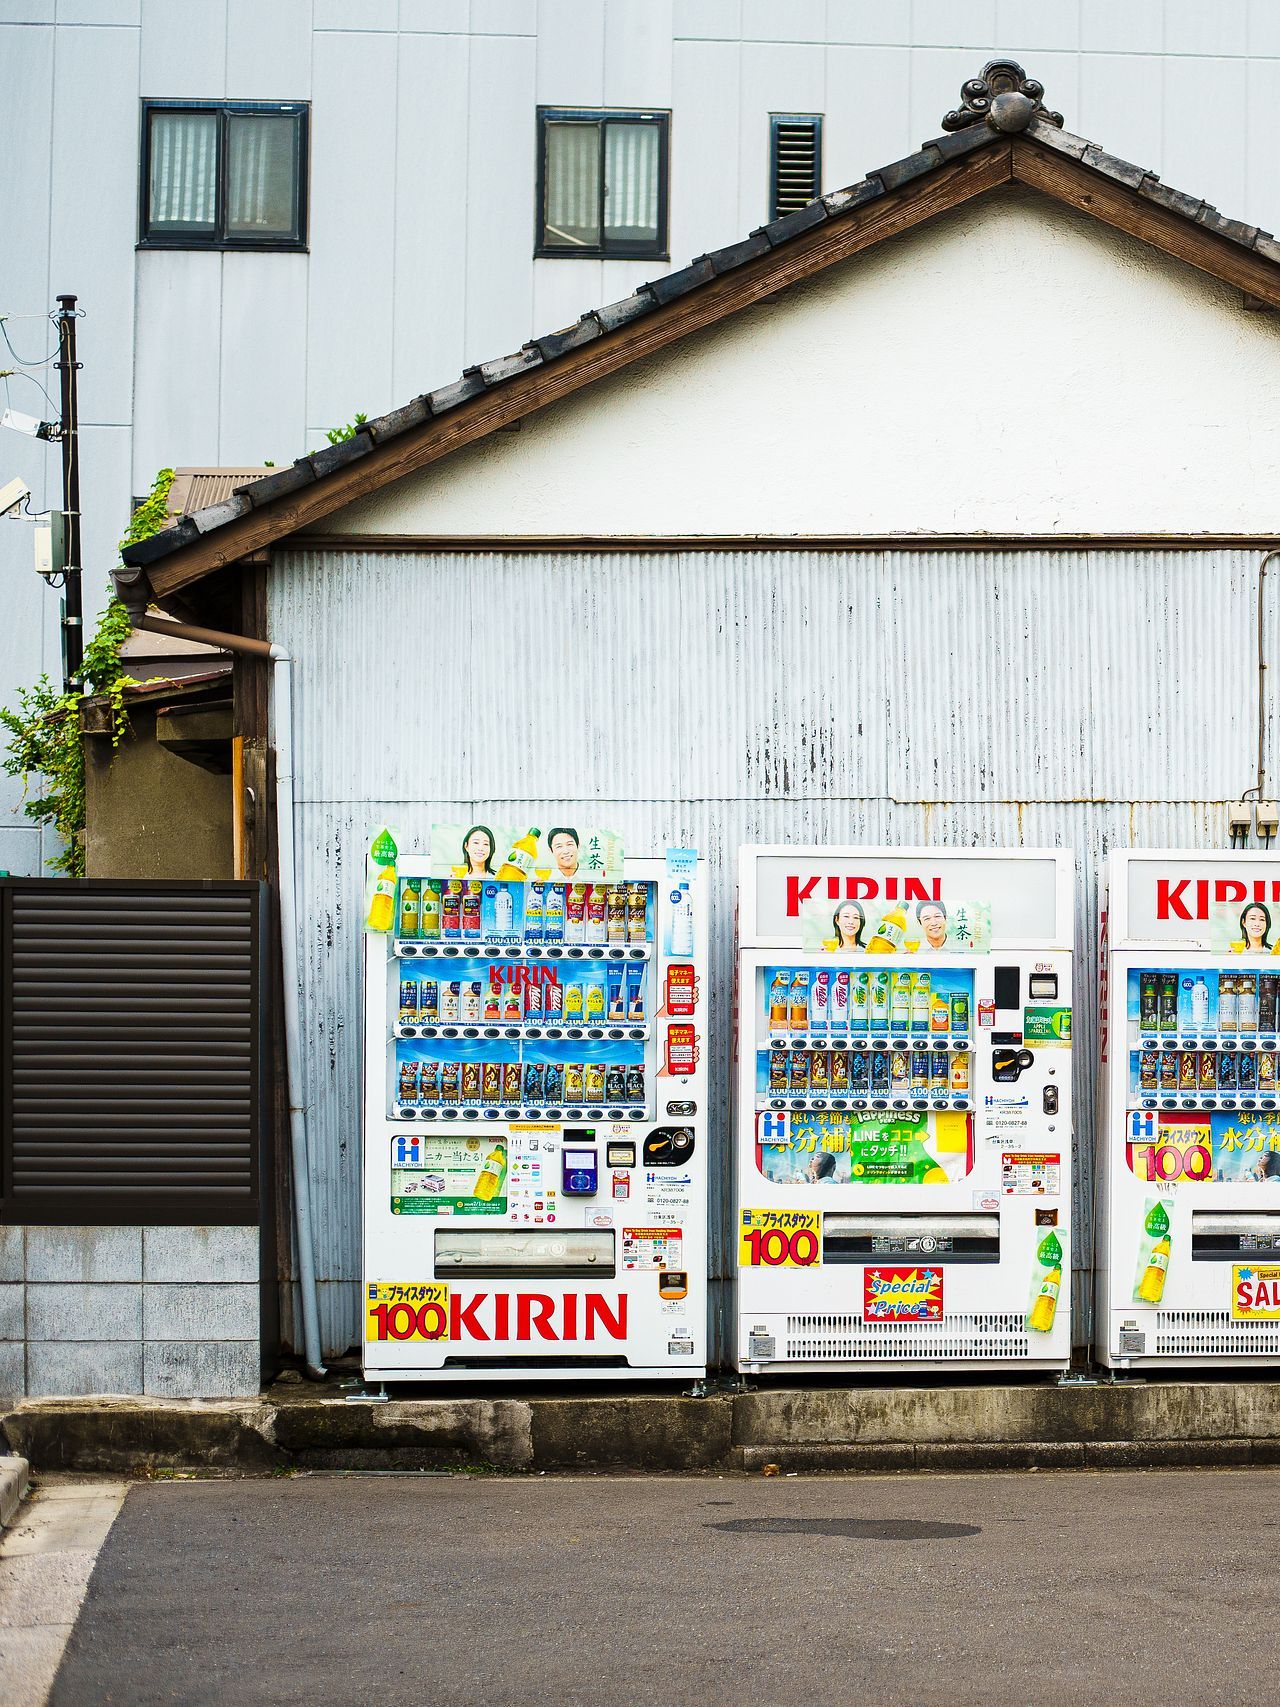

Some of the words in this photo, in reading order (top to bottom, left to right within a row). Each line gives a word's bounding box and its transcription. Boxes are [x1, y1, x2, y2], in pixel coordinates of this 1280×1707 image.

[588, 835, 604, 870] 生茶
[956, 907, 972, 941] 生茶
[489, 965, 558, 984] KIRIN
[762, 1211, 820, 1229] プライスダウン!
[388, 1286, 448, 1302] プライスダウン!
[870, 1279, 932, 1295] Special
[875, 1300, 921, 1315] Price
[450, 1293, 629, 1341] KIRIN
